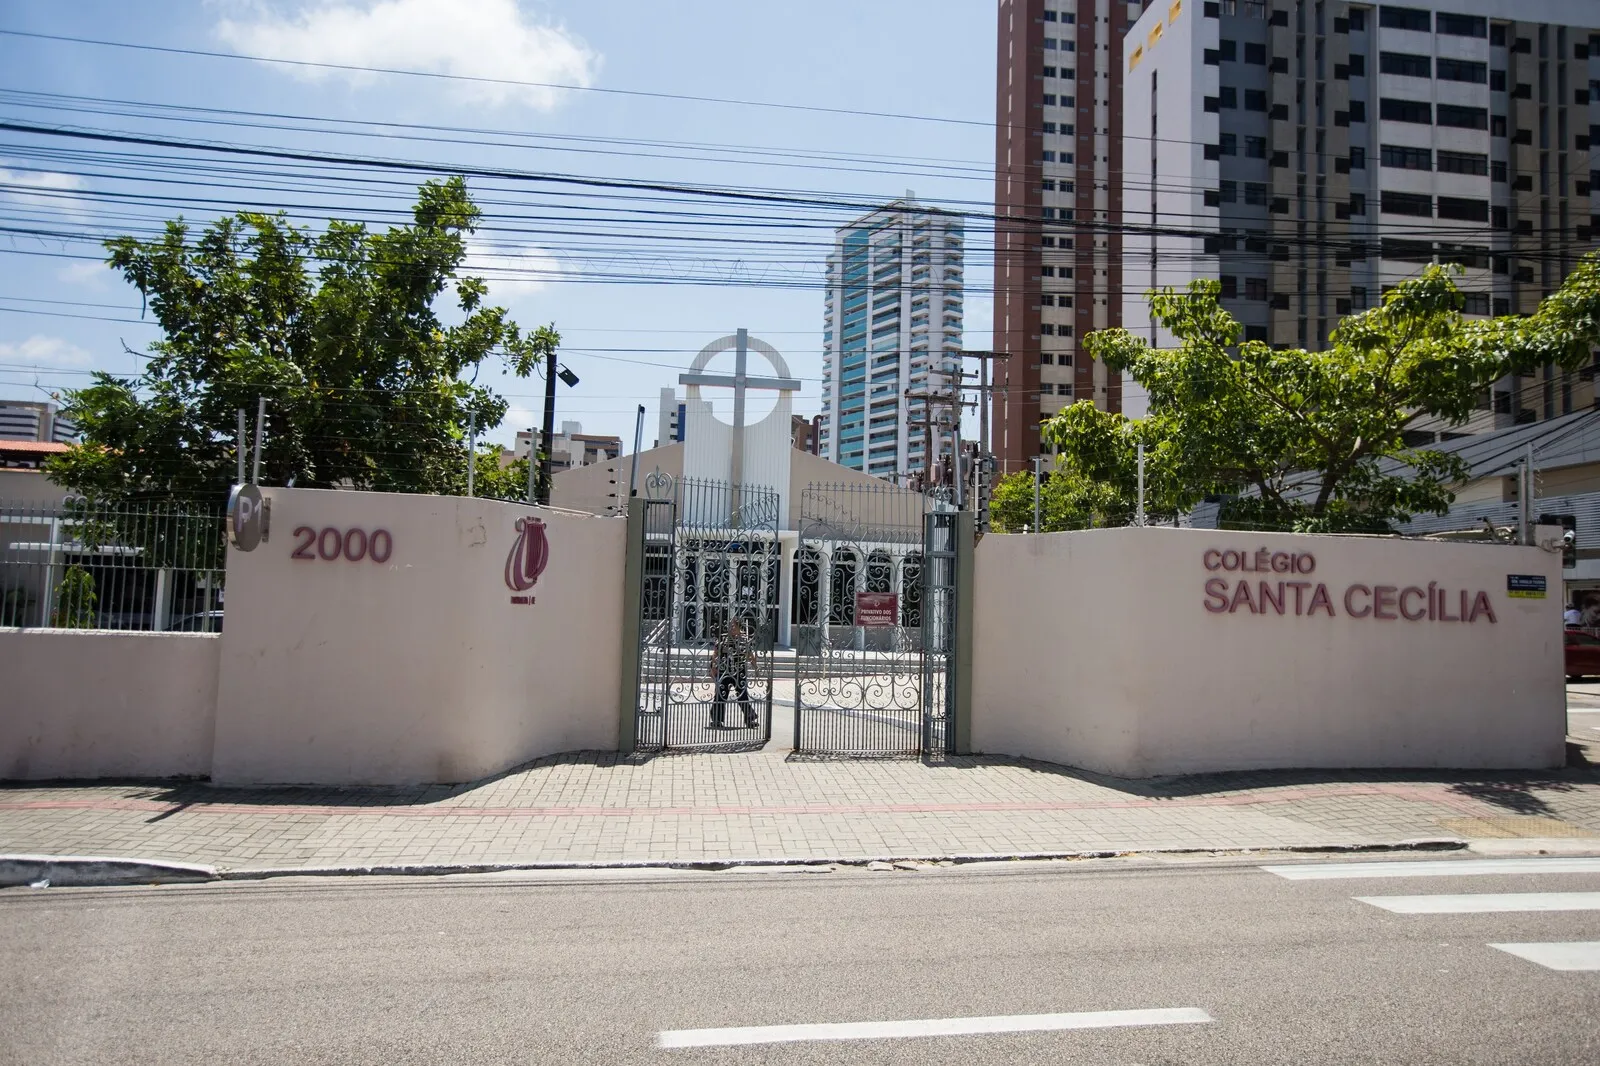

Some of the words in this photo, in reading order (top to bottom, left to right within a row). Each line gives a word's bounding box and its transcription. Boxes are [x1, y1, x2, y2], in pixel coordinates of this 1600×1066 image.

[237, 496, 263, 533] P1
[290, 526, 393, 563] 2000
[1203, 546, 1316, 574] COLÉGIO
[1203, 578, 1336, 617] SANTA
[1344, 580, 1498, 623] CECÍLIA
